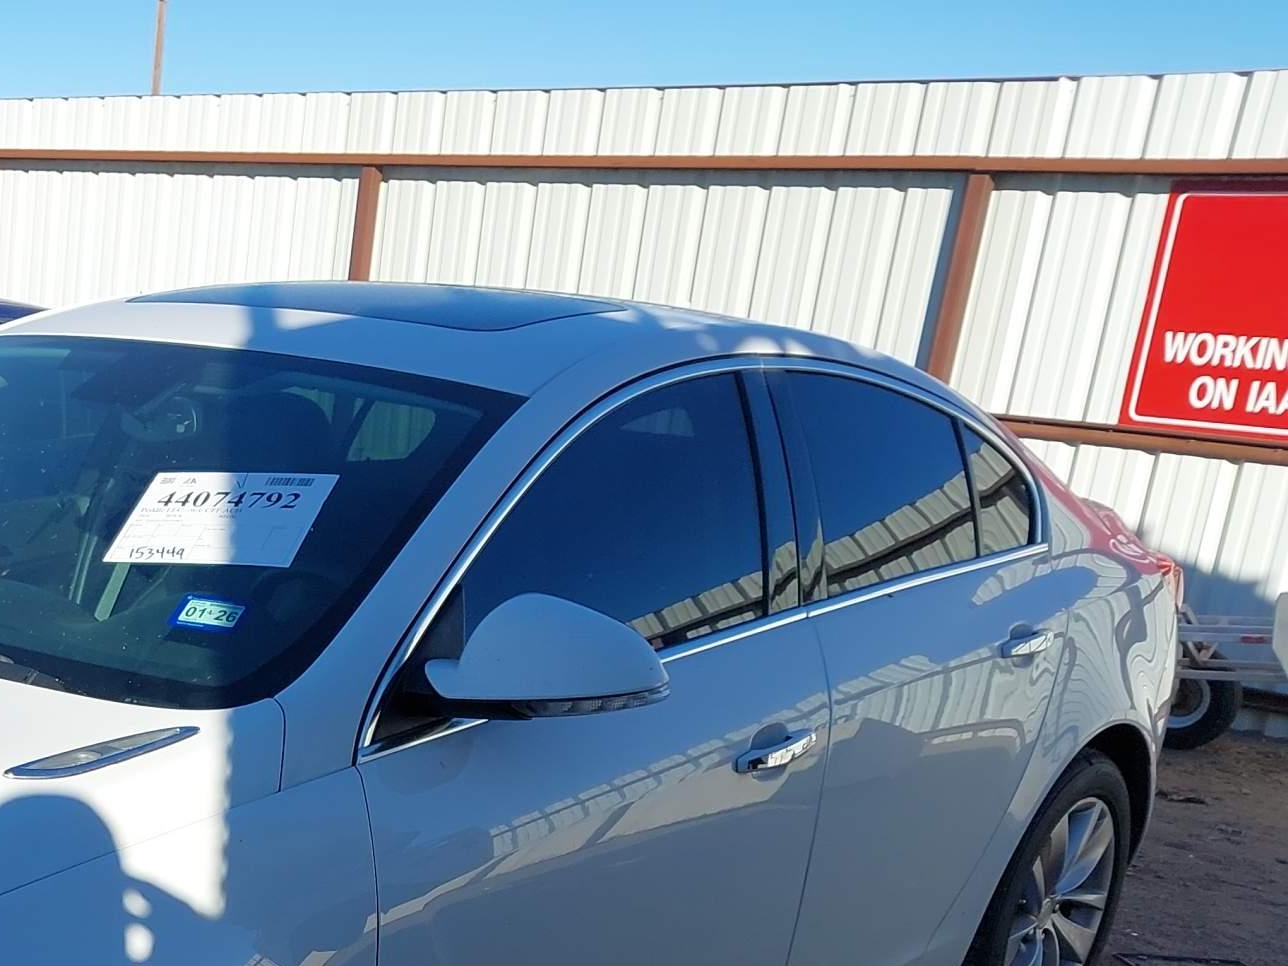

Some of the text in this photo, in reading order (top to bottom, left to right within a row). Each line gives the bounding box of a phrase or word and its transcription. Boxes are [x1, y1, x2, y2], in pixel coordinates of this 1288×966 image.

[1164, 331, 1288, 370] WORKIN
[1188, 375, 1239, 410] ON
[157, 491, 301, 508] 44074792
